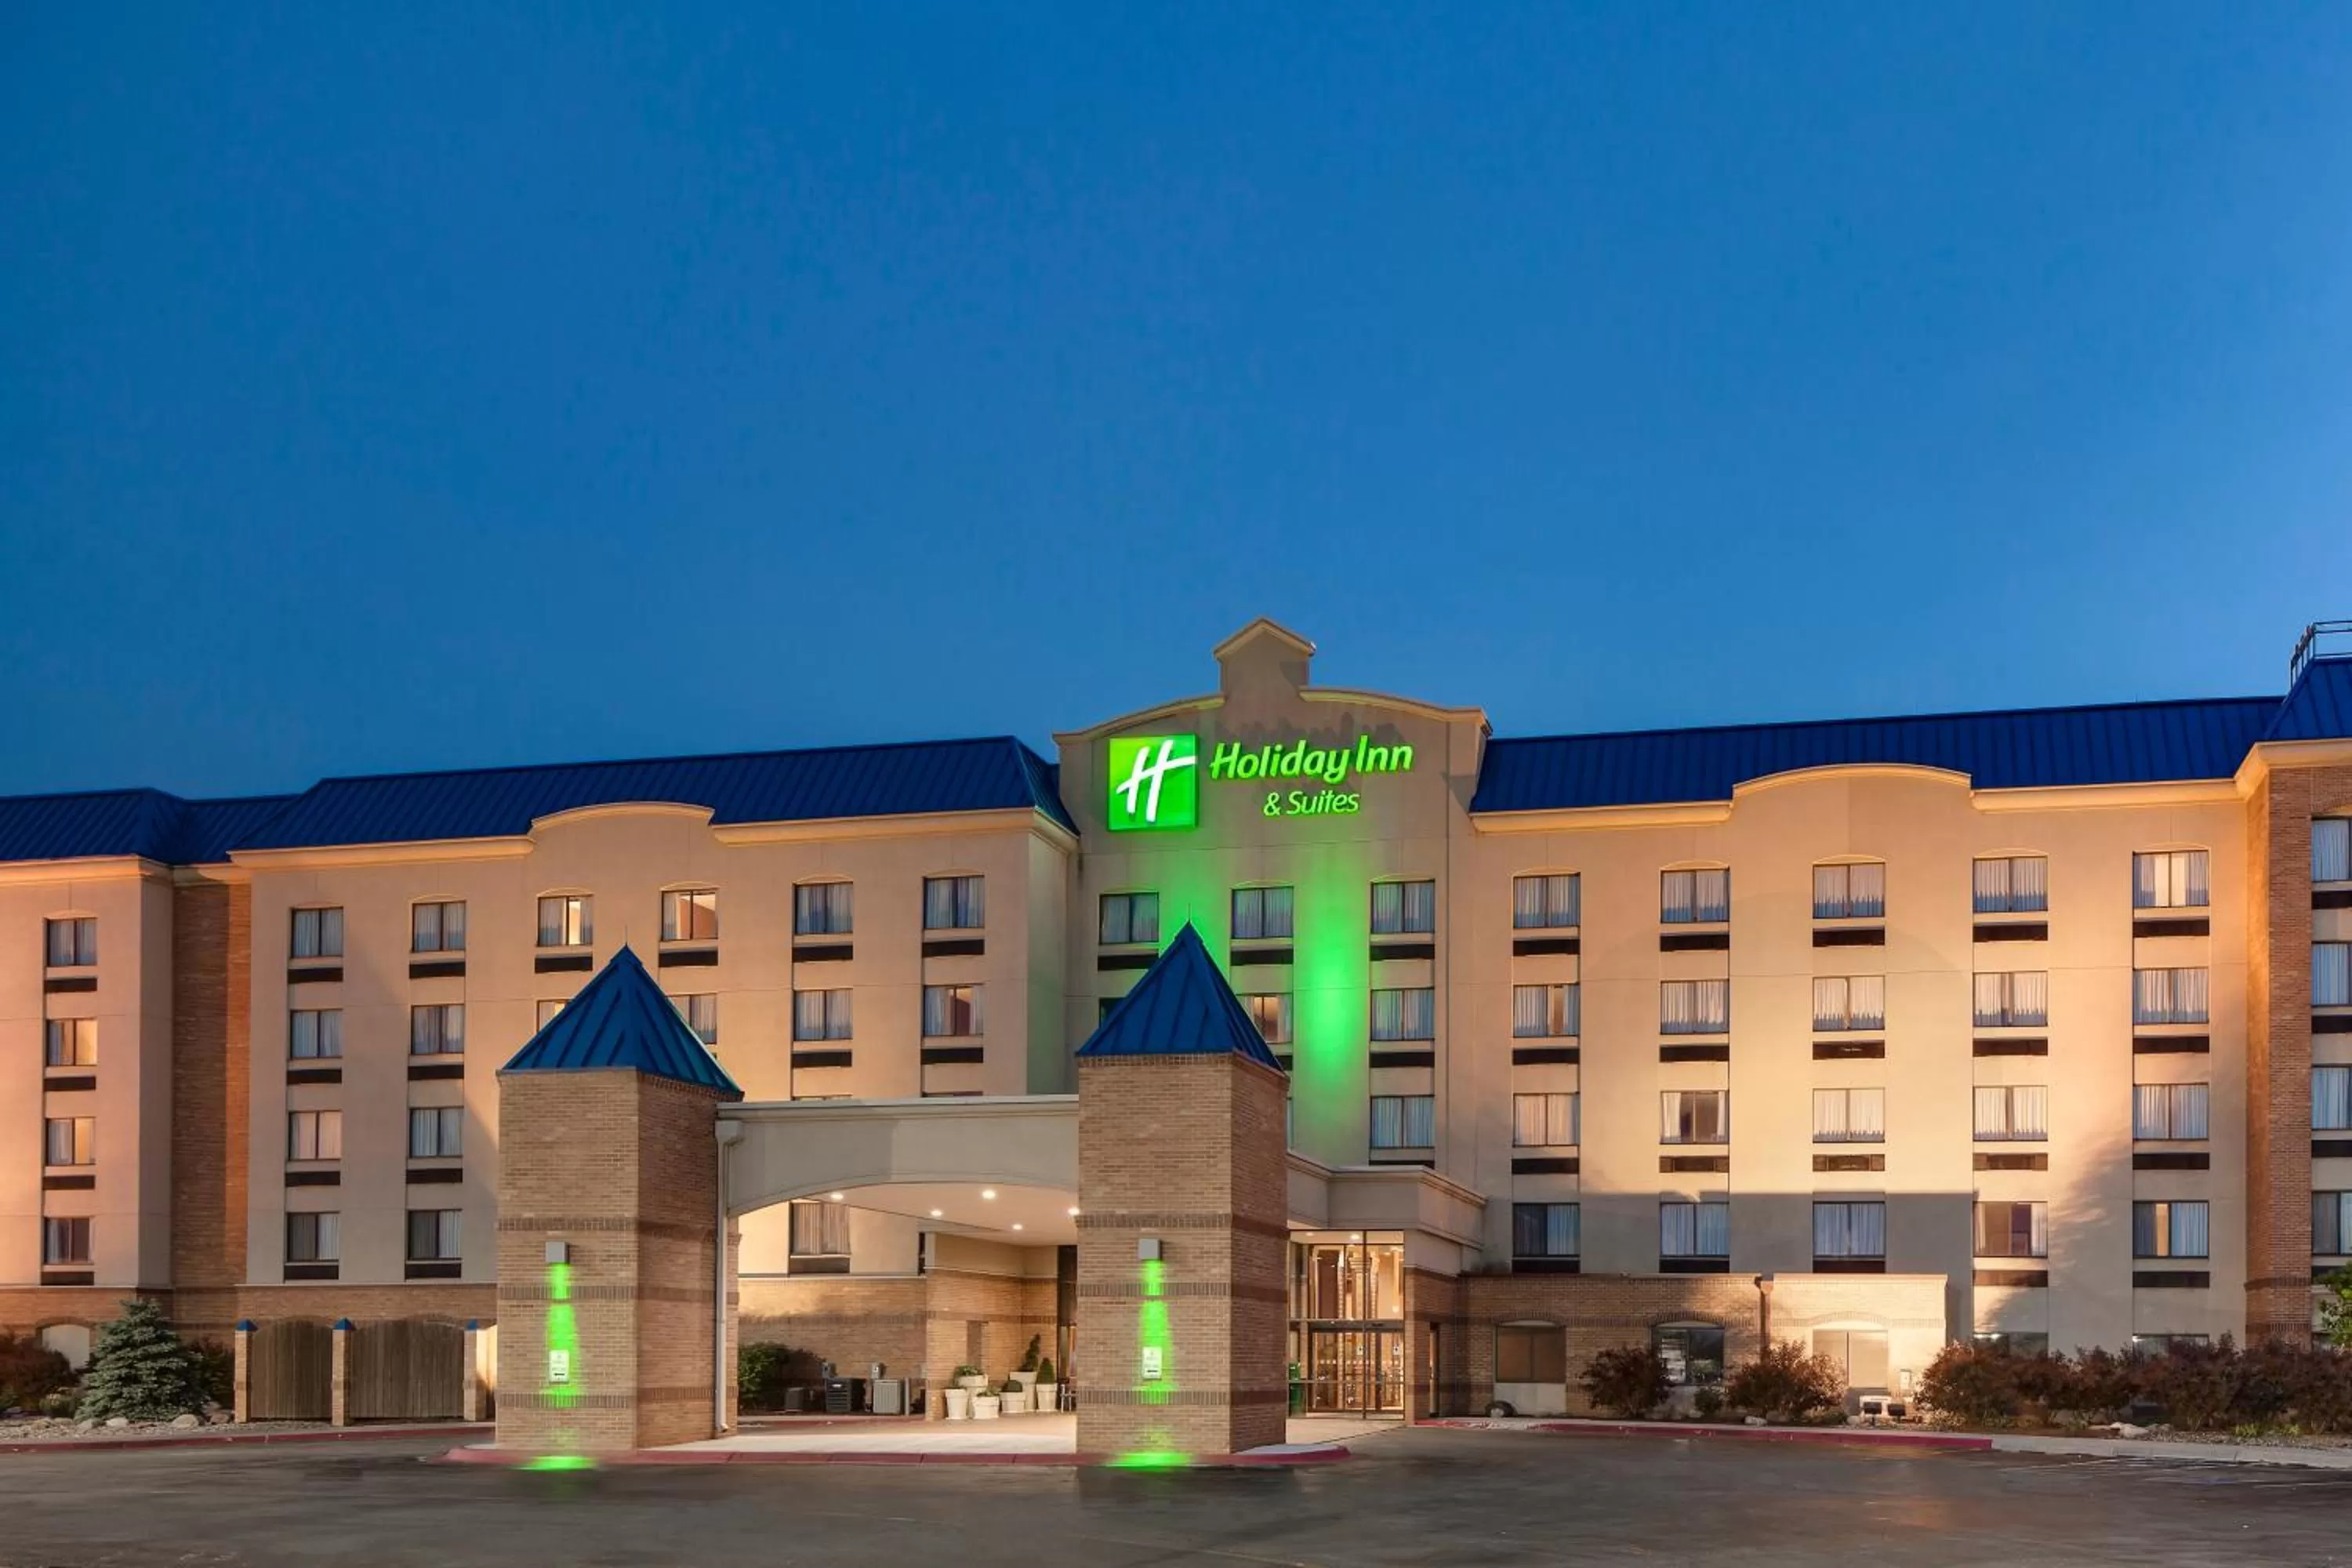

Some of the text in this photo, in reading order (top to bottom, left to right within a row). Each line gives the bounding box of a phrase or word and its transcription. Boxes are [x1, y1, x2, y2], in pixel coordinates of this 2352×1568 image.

[1210, 735, 1413, 783] Holiday Inn
[1263, 790, 1360, 816] & Suites
